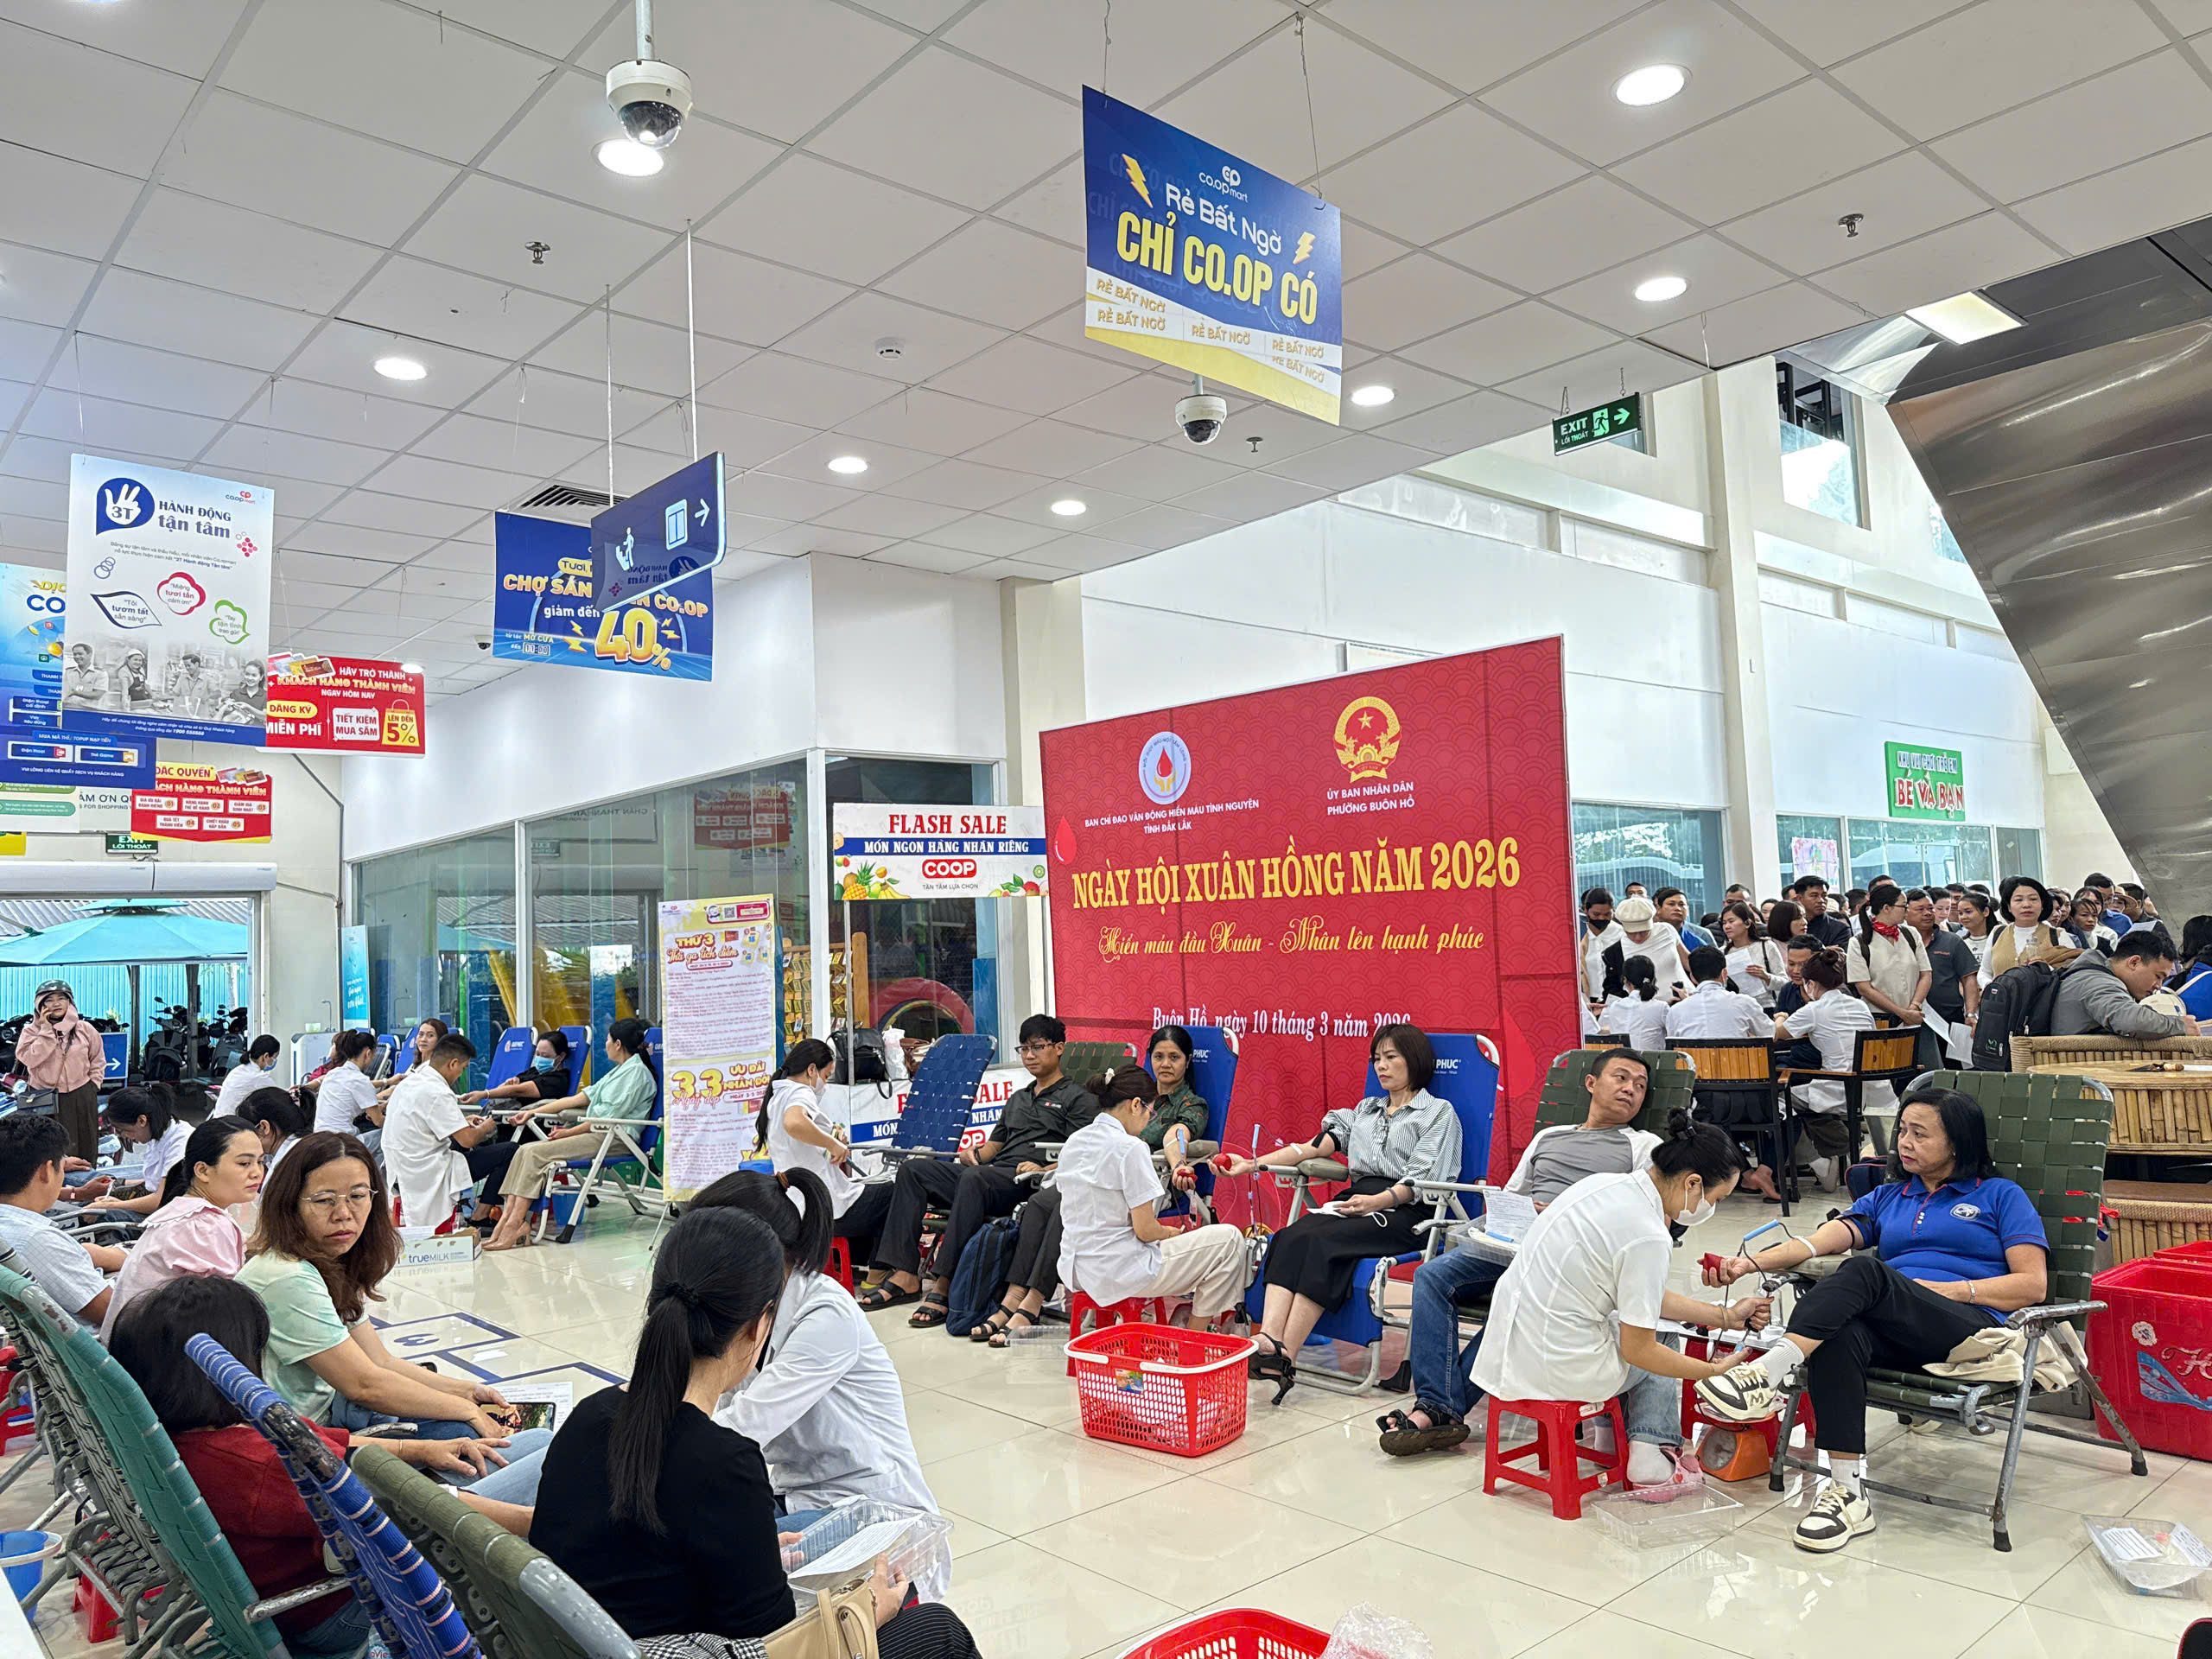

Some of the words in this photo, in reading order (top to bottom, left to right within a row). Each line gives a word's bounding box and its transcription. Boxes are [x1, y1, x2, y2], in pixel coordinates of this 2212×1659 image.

[1166, 182, 1195, 216] Rẻ
[1199, 198, 1238, 235] Bất
[1242, 216, 1282, 257] Ngờ
[1116, 211, 1176, 276] CHỈ
[1183, 235, 1274, 307] CO.OP
[1281, 270, 1319, 325] CÓ
[1096, 278, 1113, 294] RẺ
[1115, 285, 1138, 304] BẤT
[1140, 296, 1166, 313] NGỜ
[1097, 308, 1114, 323] RẺ
[1116, 309, 1139, 327] BẤT
[1141, 316, 1166, 331] NGỜ
[1560, 416, 1588, 435] EXIT
[1571, 430, 1588, 442] THOÁT
[111, 505, 134, 520] 3T
[159, 500, 194, 515] HÀNH
[198, 506, 232, 522] ĐỘNG
[158, 514, 189, 532] tận
[195, 520, 231, 538] tâm
[27, 594, 66, 613] CO
[503, 574, 547, 598] CHỢ
[654, 594, 709, 617] CO.OP
[111, 605, 136, 613] tươm
[137, 605, 149, 615] tất
[543, 604, 575, 620] giảm
[577, 604, 601, 619] đến
[594, 607, 671, 671] 40%
[378, 669, 406, 680] THÀNH
[300, 721, 322, 736] PHÍ
[335, 713, 353, 724] TIẾT
[335, 726, 356, 735] MUA
[387, 722, 416, 744] 5%
[1326, 787, 1339, 801] ỦY
[1341, 787, 1361, 799] BAN
[1363, 782, 1390, 797] NHÂN
[1393, 779, 1414, 793] DÂN
[1894, 768, 1915, 809] BÉ
[1914, 771, 1936, 810] VÀ
[1936, 781, 1964, 818] BẠN
[1085, 818, 1099, 828] BAN
[1100, 814, 1111, 825] CHỈ
[1112, 815, 1128, 824] ĐẠO
[1128, 811, 1144, 823] VẬN
[1145, 809, 1167, 821] ĐỘNG
[1168, 804, 1186, 817] HIẾN
[1187, 803, 1205, 815] MÁU
[1205, 801, 1224, 813] TÌNH
[1225, 798, 1259, 811] NGUYỆN
[1326, 801, 1367, 816] PHƯỜNG
[1370, 798, 1397, 812] BUÔN
[1399, 793, 1415, 809] HỒ
[888, 814, 952, 834] FLASH
[960, 815, 1007, 835] SALE
[1178, 817, 1192, 831] LẮK
[864, 838, 889, 853] MÓN
[893, 839, 925, 854] NGON
[928, 839, 959, 854] HÀNG
[998, 838, 1029, 853] RIÊNG
[924, 861, 976, 877] COOP
[1071, 858, 1131, 909] NGÀY
[1135, 855, 1180, 915] HỘI
[1184, 850, 1255, 902] XUÂN
[1260, 834, 1345, 898] HỒNG
[1349, 836, 1425, 893] NĂM
[1430, 836, 1521, 890] 2026
[702, 932, 715, 948] 3
[1098, 925, 1140, 963] Hiến
[1144, 934, 1174, 954] máu
[1179, 931, 1207, 954] đầu
[1210, 920, 1262, 954] Xuân
[1280, 914, 1341, 954] Nhân
[1347, 925, 1375, 950] lên
[1381, 924, 1430, 955] hạnh
[1436, 922, 1484, 955] phúc
[1152, 1007, 1184, 1030] Buôn
[1214, 1011, 1248, 1039] ngày
[1252, 1010, 1268, 1034] 10
[1271, 1009, 1315, 1042] tháng
[1319, 1011, 1328, 1036] 3
[1333, 1010, 1369, 1037] năm
[671, 1068, 724, 1099] 3.3
[873, 1120, 899, 1137] MÓN
